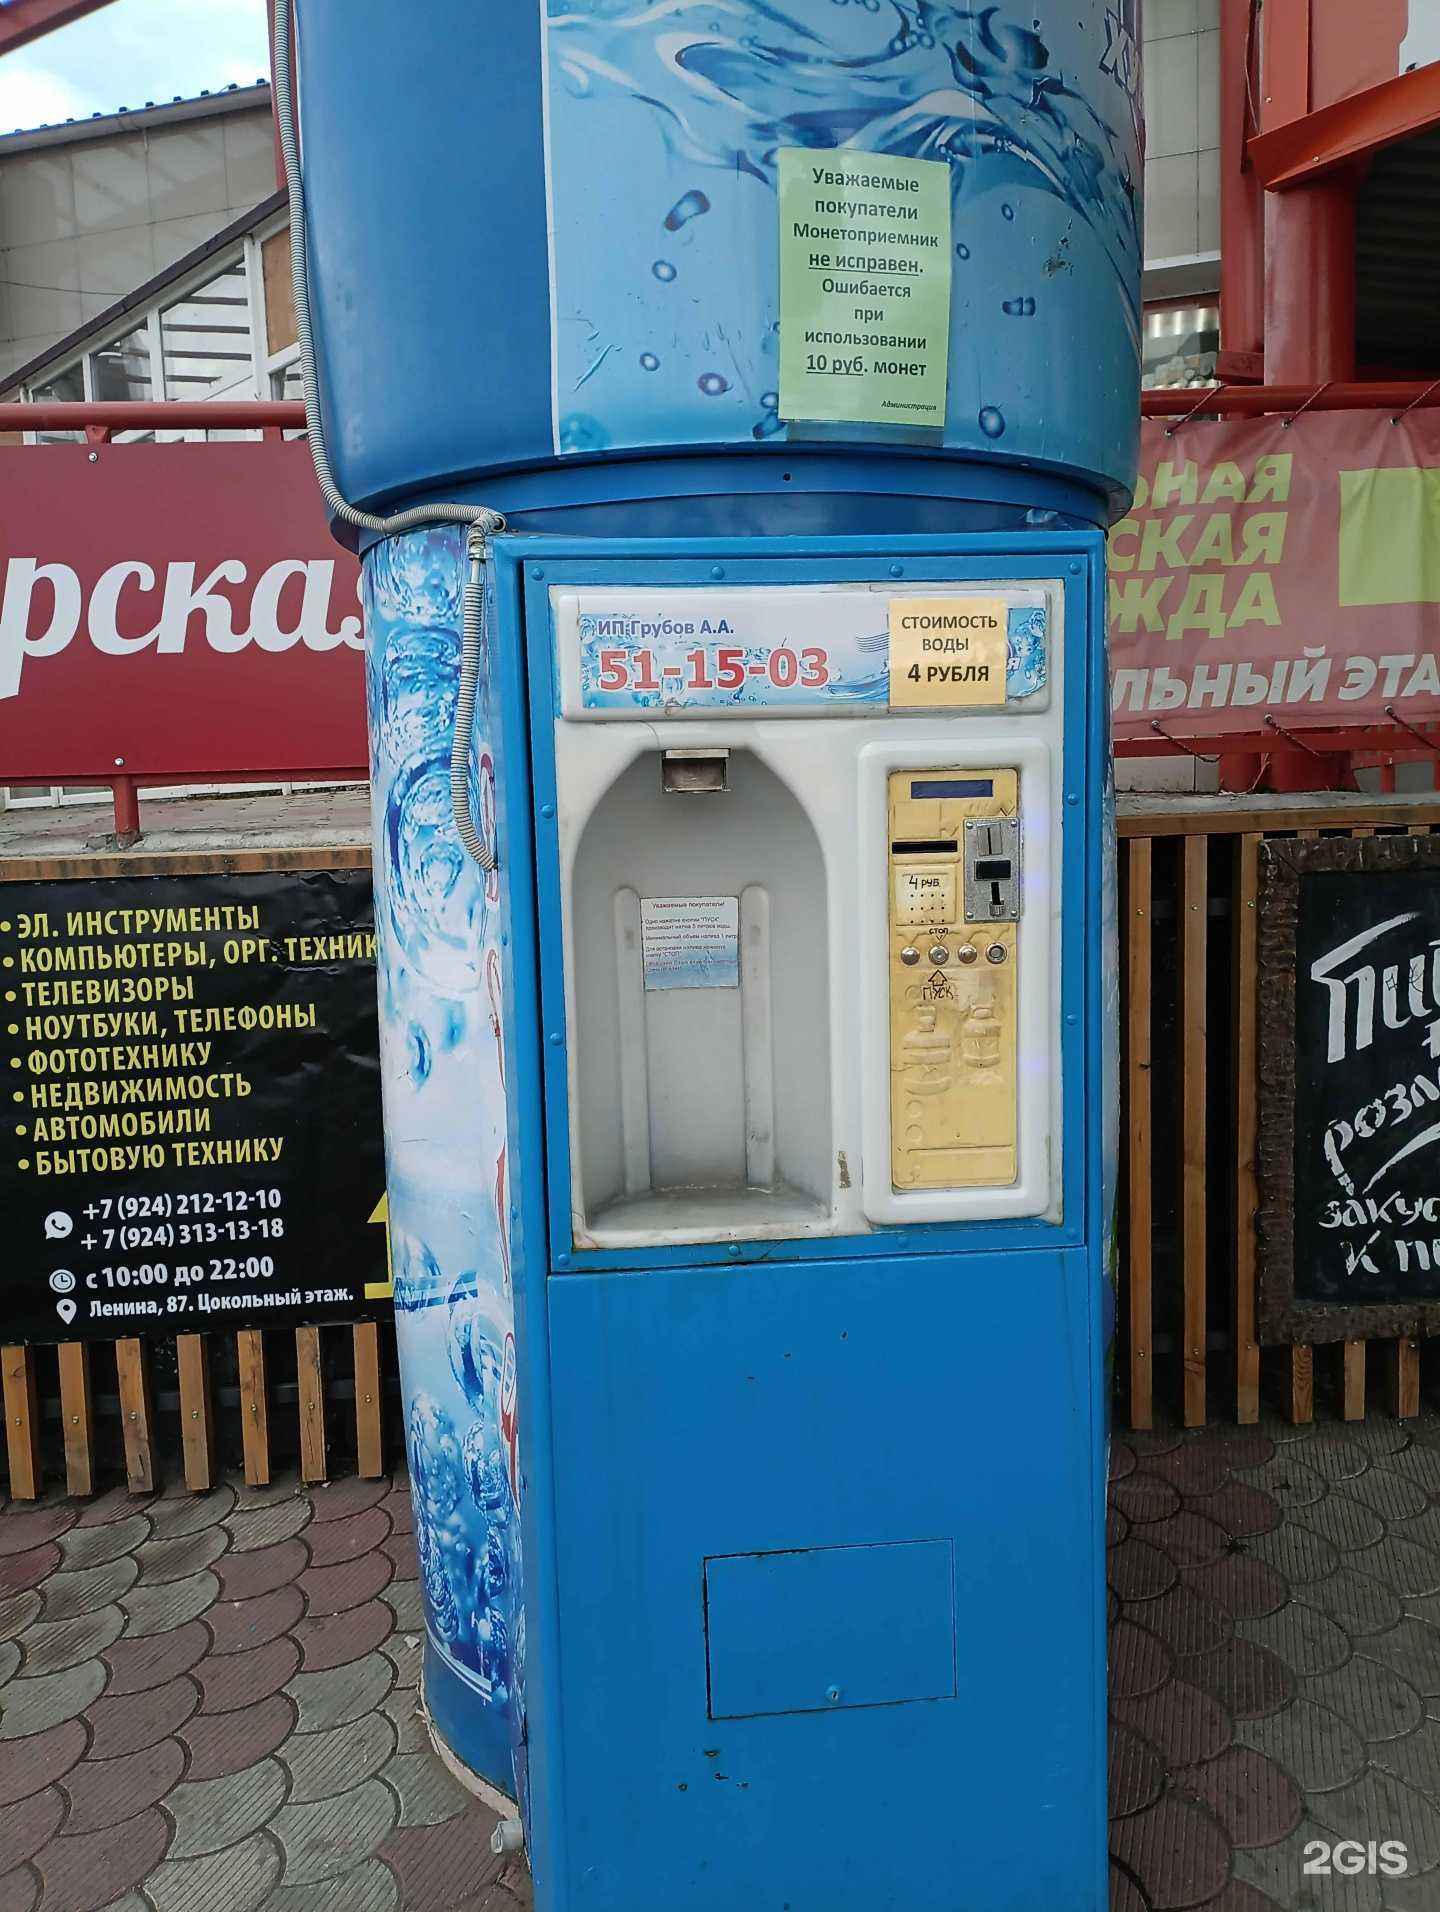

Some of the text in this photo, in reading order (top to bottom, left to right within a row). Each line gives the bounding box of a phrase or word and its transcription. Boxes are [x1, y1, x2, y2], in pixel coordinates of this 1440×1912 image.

[812, 167, 919, 192] Уважаемые
[815, 198, 918, 219] покупатели
[793, 223, 938, 247] Монетоприемник
[809, 252, 924, 273] не исправен.
[822, 278, 911, 298] Ошибается
[854, 308, 884, 324] при
[805, 330, 927, 350] использовании
[806, 354, 927, 376] 10 руб. монет
[881, 400, 937, 412] Администрация
[1108, 511, 1288, 572] СКАЯ
[1109, 572, 1282, 640] ЖДА
[598, 619, 735, 638] ИП Грубов А.А.
[901, 615, 998, 630] СТОИМОСТЬ
[922, 638, 969, 653] ВОДЫ
[599, 647, 830, 690] 51-15-03
[907, 664, 989, 682] 4 РУБЛЯ
[1112, 645, 1440, 712] ЛЬНЫЙ ЭТА
[909, 875, 918, 890] 4
[17, 905, 260, 939] ЭЛ. ИНСТРУМЕНТЫ
[20, 934, 377, 973] КОМПЬЮТЕРЫ, ОРГ. ТЕХНИК
[22, 976, 194, 1007] ТЕЛЕВИЗОРЫ
[923, 986, 954, 1001] ПУСК
[1311, 912, 1440, 1064] Пи
[26, 1003, 316, 1041] НОУТБУКИ, ТЕЛЕФОНЫ
[28, 1042, 212, 1075] ФОТОТЕХНИКУ
[31, 1072, 252, 1112] НЕДВИЖИМОСТЬ
[33, 1108, 211, 1142] АВТОМОБИЛИ
[1323, 1067, 1440, 1197] розл
[37, 1137, 284, 1175] БЫТОВУЮ ТЕХНИКУ
[117, 1193, 172, 1220] (924)
[176, 1188, 282, 1214] 212-12-10
[120, 1223, 175, 1250] (924)
[179, 1218, 284, 1245] 313-13-18
[102, 1263, 168, 1288] 10:00
[174, 1266, 204, 1287] до
[209, 1256, 275, 1281] 22:00
[89, 1286, 354, 1318] Ленина, 87. Цокольный этаж.
